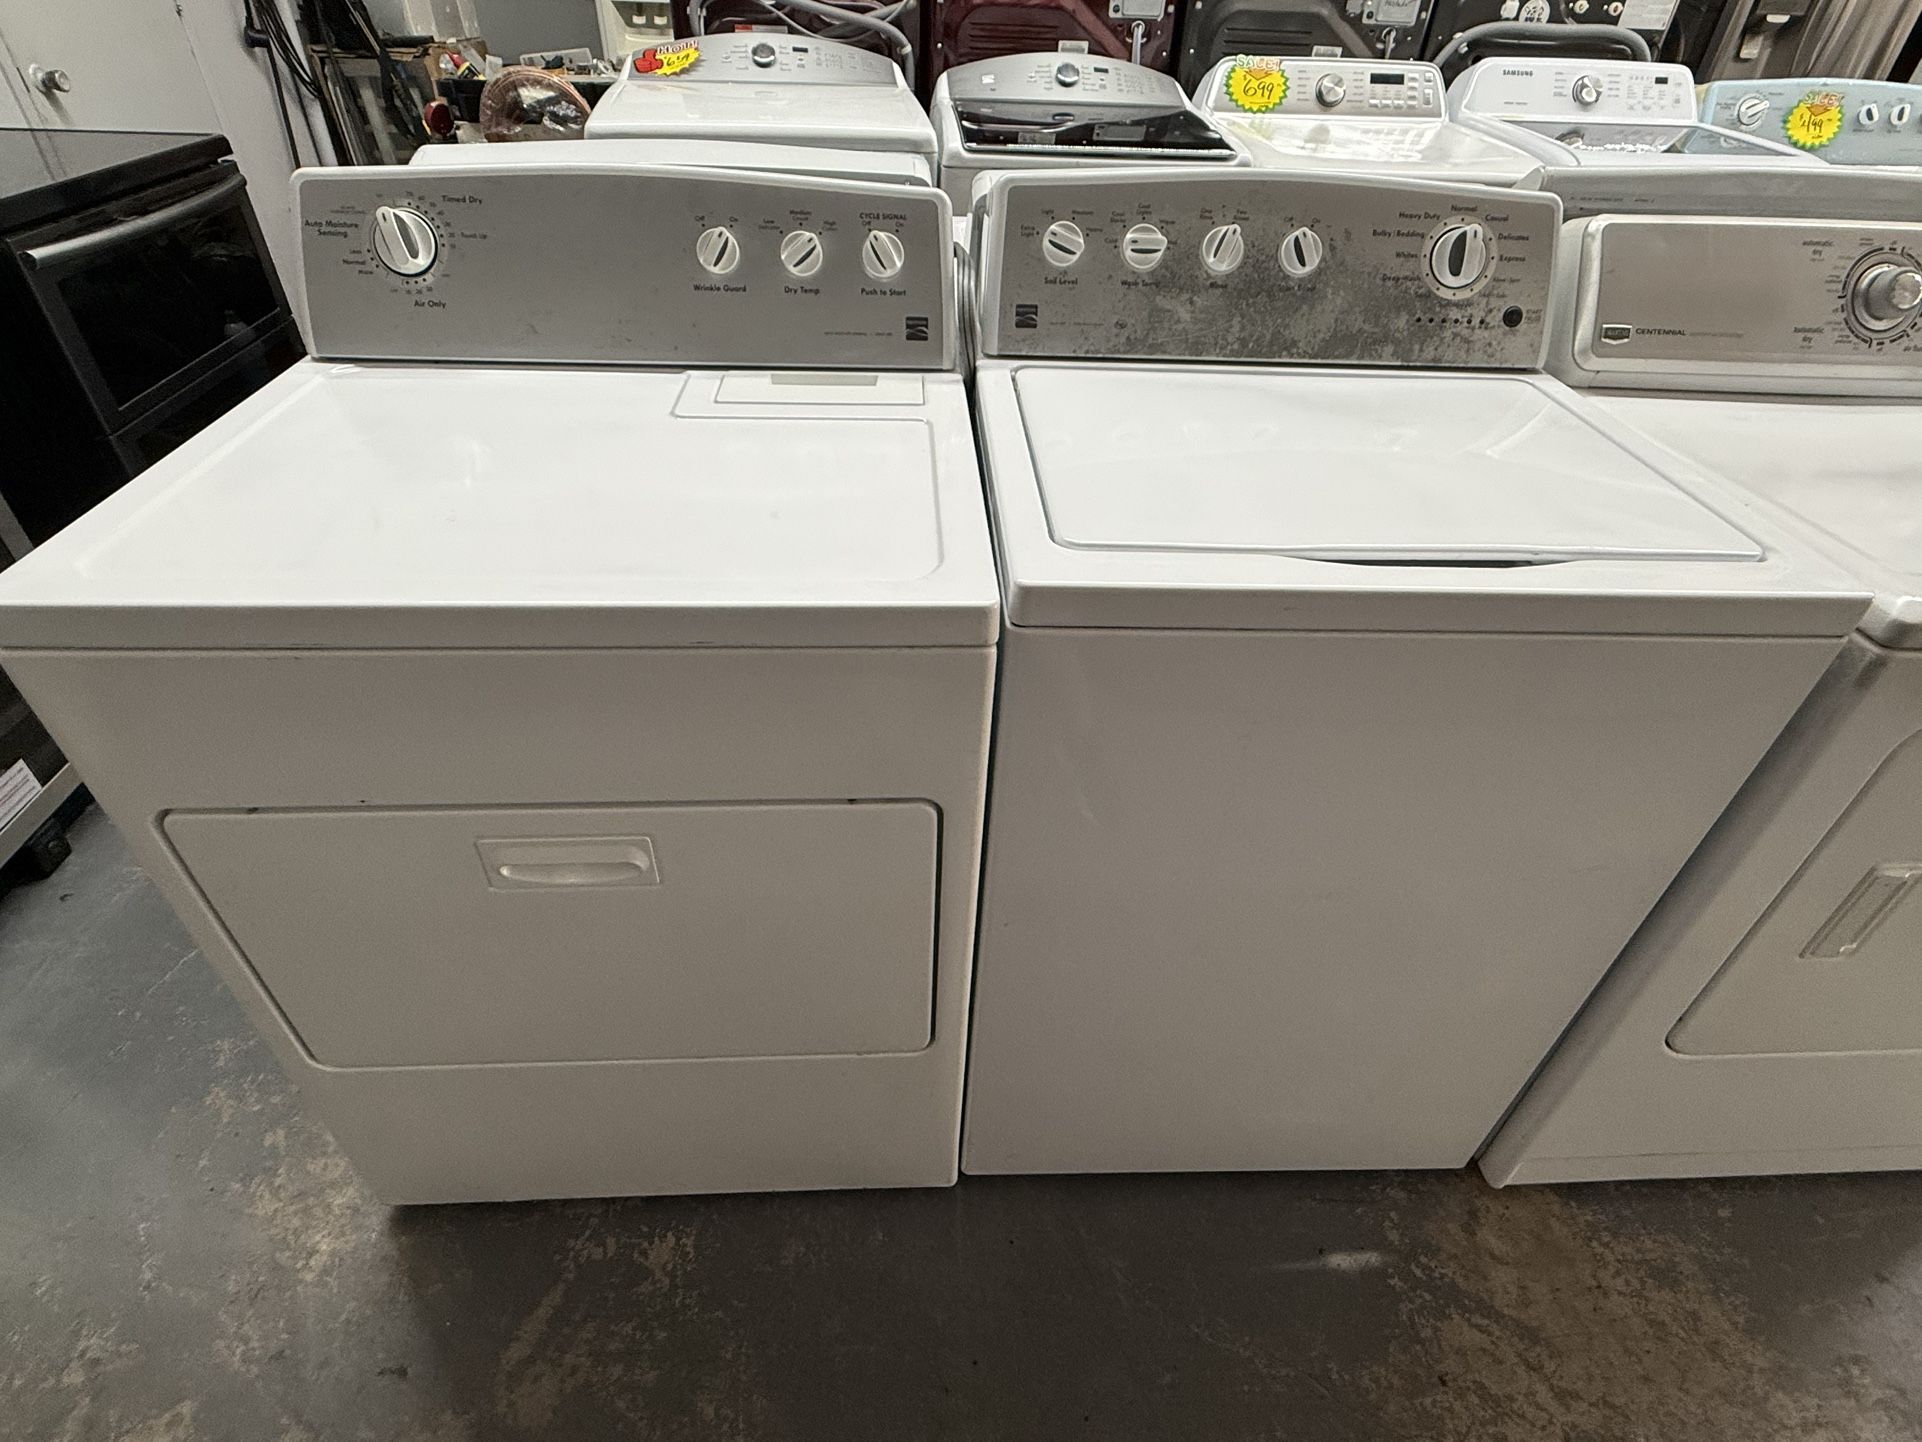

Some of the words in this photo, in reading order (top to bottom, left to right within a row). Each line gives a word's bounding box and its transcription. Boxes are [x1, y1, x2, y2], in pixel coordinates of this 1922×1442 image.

[442, 195, 466, 203] Timed
[468, 196, 483, 205] Dry
[1451, 204, 1478, 212] Normal
[859, 212, 880, 220] CYCLE
[882, 212, 907, 221] SIGNAL
[1398, 211, 1423, 220] Heavy
[1424, 212, 1441, 221] Duty
[304, 219, 323, 228] Auto
[325, 220, 359, 228] Moisture
[317, 229, 348, 238] Sensing
[1498, 233, 1529, 241] Delicates
[1499, 254, 1526, 263] Express
[1044, 276, 1058, 285] Soil
[1058, 277, 1078, 285] Level
[693, 284, 721, 292] Wrinkle
[723, 284, 747, 292] Guard
[784, 285, 797, 294] Dry
[800, 286, 820, 295] Temp
[860, 288, 878, 296] Push
[889, 288, 906, 296] Start
[427, 300, 447, 309] Only
[1635, 327, 1687, 336] CENTENNIAL
